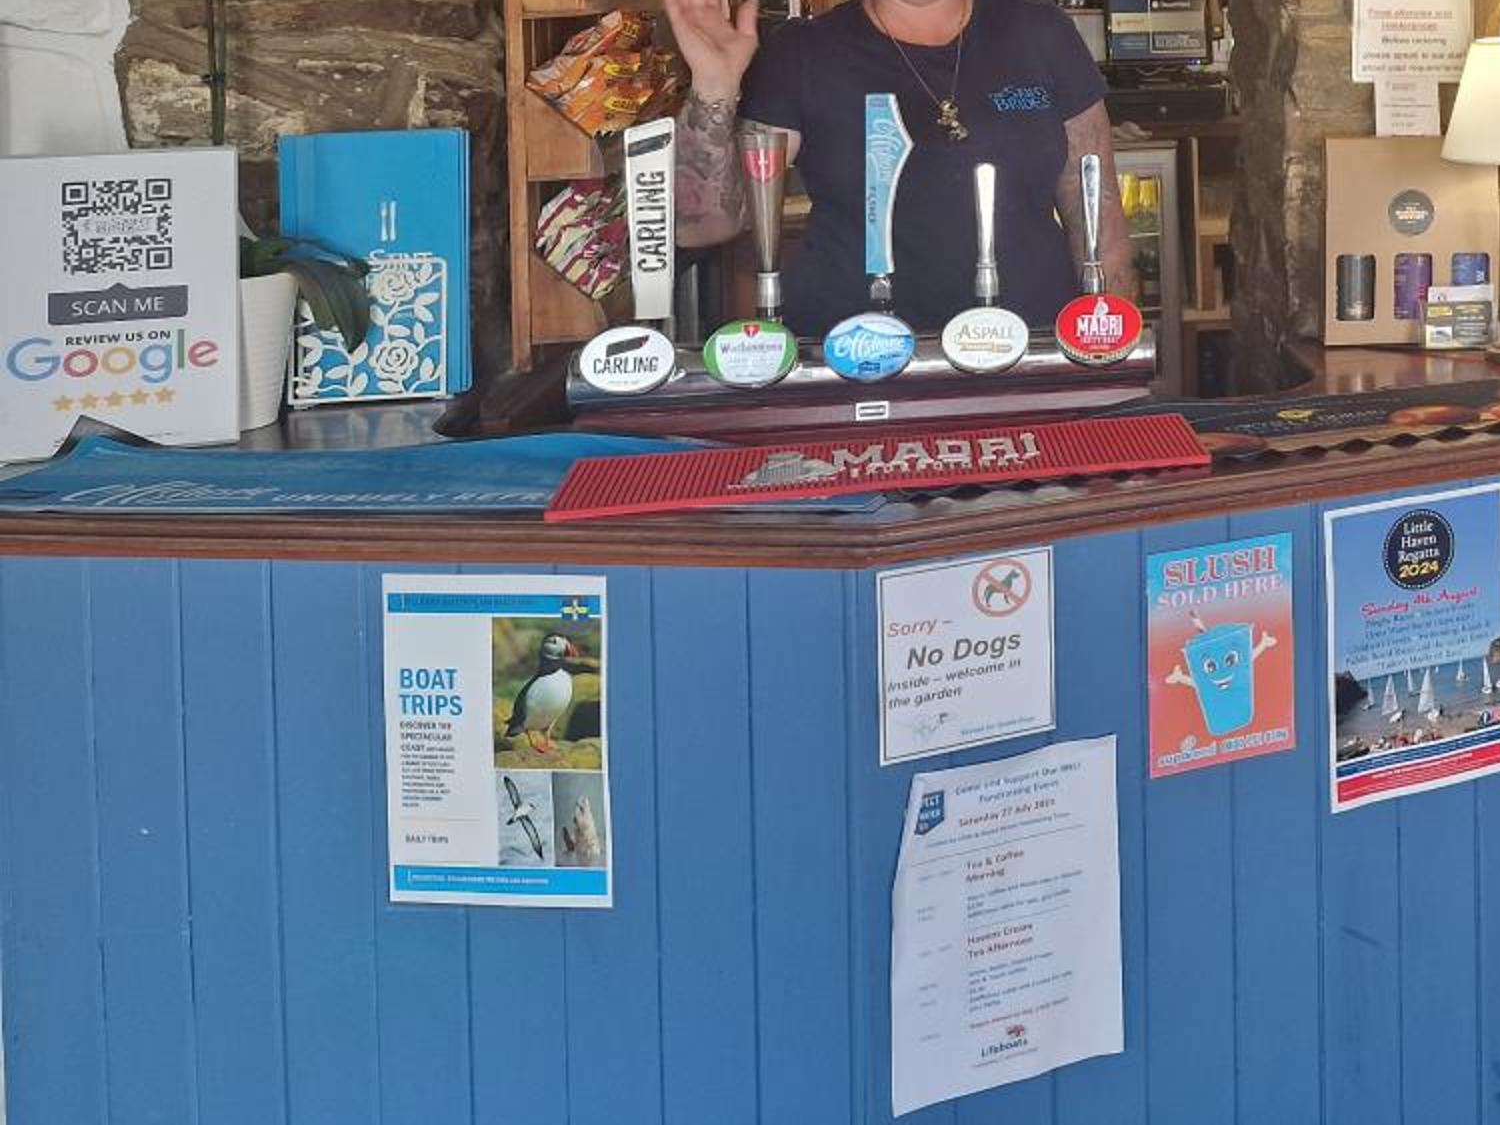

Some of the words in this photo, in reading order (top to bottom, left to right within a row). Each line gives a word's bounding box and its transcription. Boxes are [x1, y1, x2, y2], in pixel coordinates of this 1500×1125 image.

[635, 170, 668, 274] CARLING
[71, 298, 128, 317] SCAN
[133, 295, 165, 313] ME
[64, 332, 122, 347] REVIEW
[124, 331, 145, 344] US
[148, 329, 172, 342] ON
[958, 324, 1016, 341] ASPALL
[6, 328, 220, 384] Google
[592, 355, 660, 376] CARLING
[1403, 520, 1435, 536] Little
[1401, 534, 1438, 550] Haven
[1397, 546, 1441, 564] Regatta
[1163, 545, 1277, 589] SLUSH
[1399, 560, 1440, 578] 2024
[1156, 585, 1218, 609] SOLD
[1223, 574, 1284, 600] HERE
[1360, 599, 1410, 619] Sunday
[1437, 586, 1481, 604] August
[887, 618, 938, 639] Sorry
[906, 645, 944, 670] No
[952, 633, 1022, 660] Dogs
[399, 668, 458, 690] BOAT
[945, 662, 1005, 683] welcome
[399, 695, 464, 717] TRIPS
[887, 695, 911, 710] the
[913, 686, 963, 708] garden
[400, 732, 452, 742] SPECTACULAR
[958, 811, 1000, 828] Saturday
[980, 1037, 1029, 1059] Lifeboats
